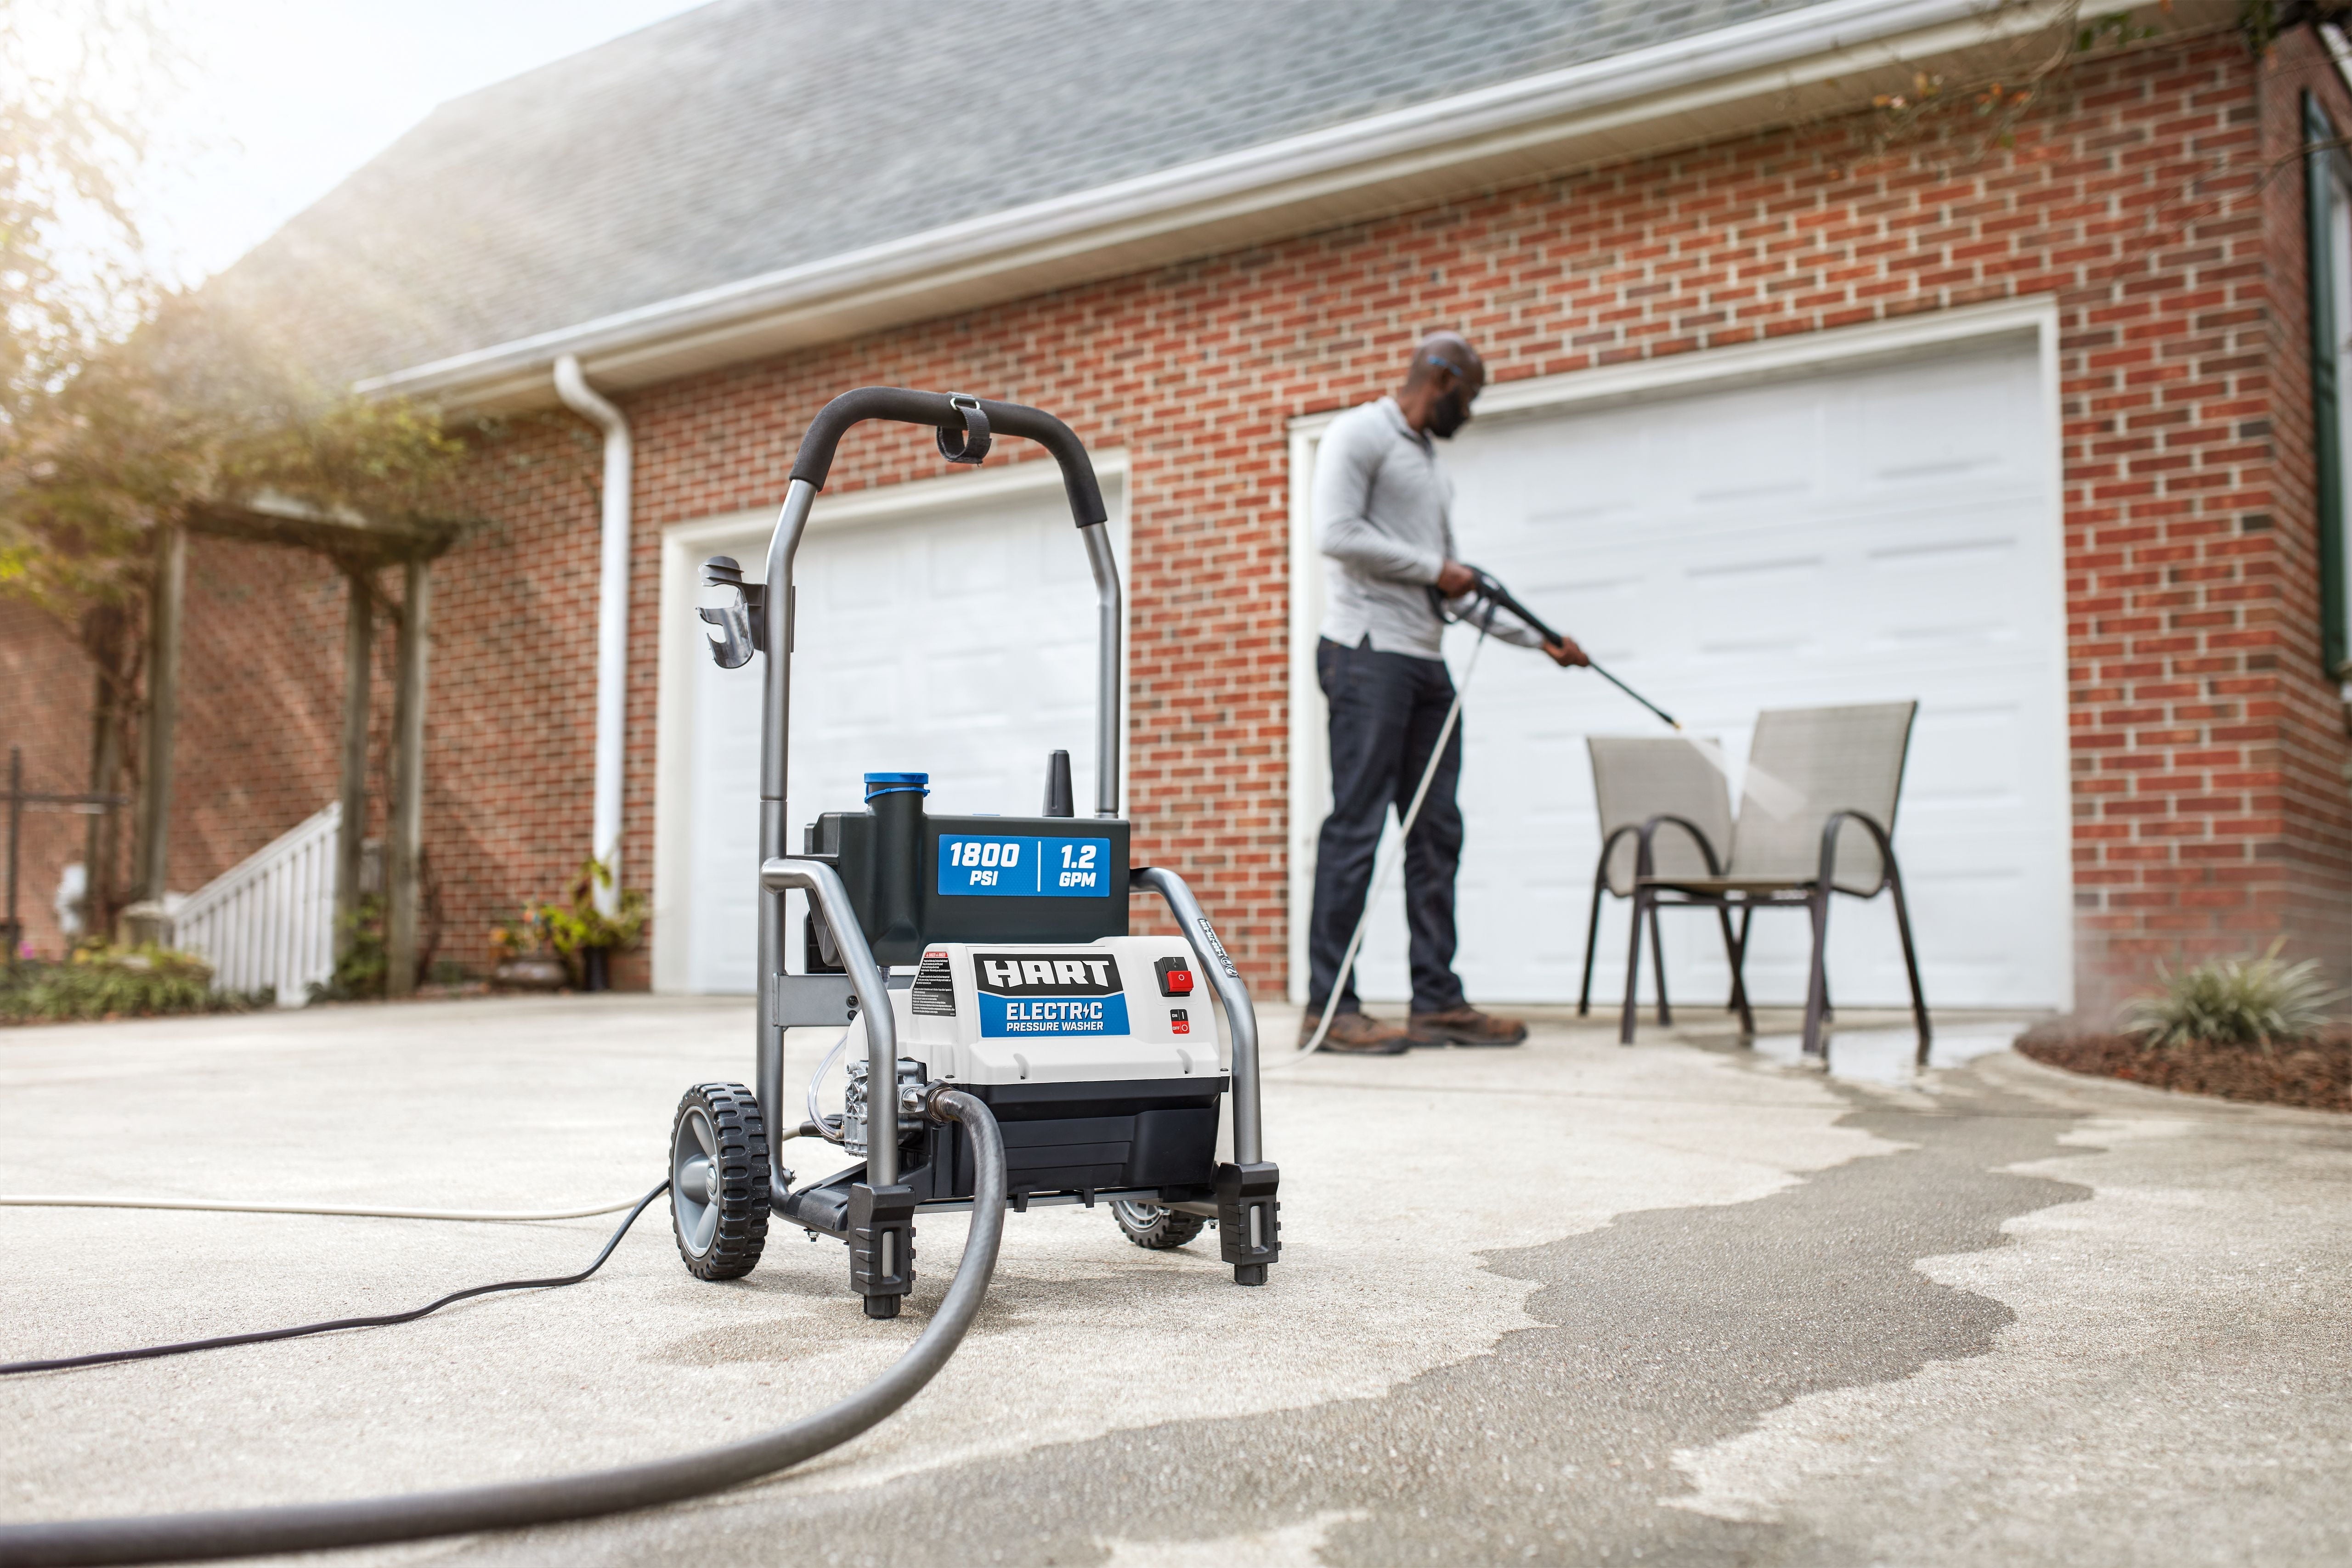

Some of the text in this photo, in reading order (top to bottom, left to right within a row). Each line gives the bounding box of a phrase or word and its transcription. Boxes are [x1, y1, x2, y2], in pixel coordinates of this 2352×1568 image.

[950, 842, 1020, 867] 1800
[1061, 845, 1097, 869] 1.2
[969, 870, 999, 886] PSI
[1059, 872, 1097, 887] GPM
[983, 960, 1110, 987] HART
[1006, 1021, 1103, 1032] PRESSURE WASHER
